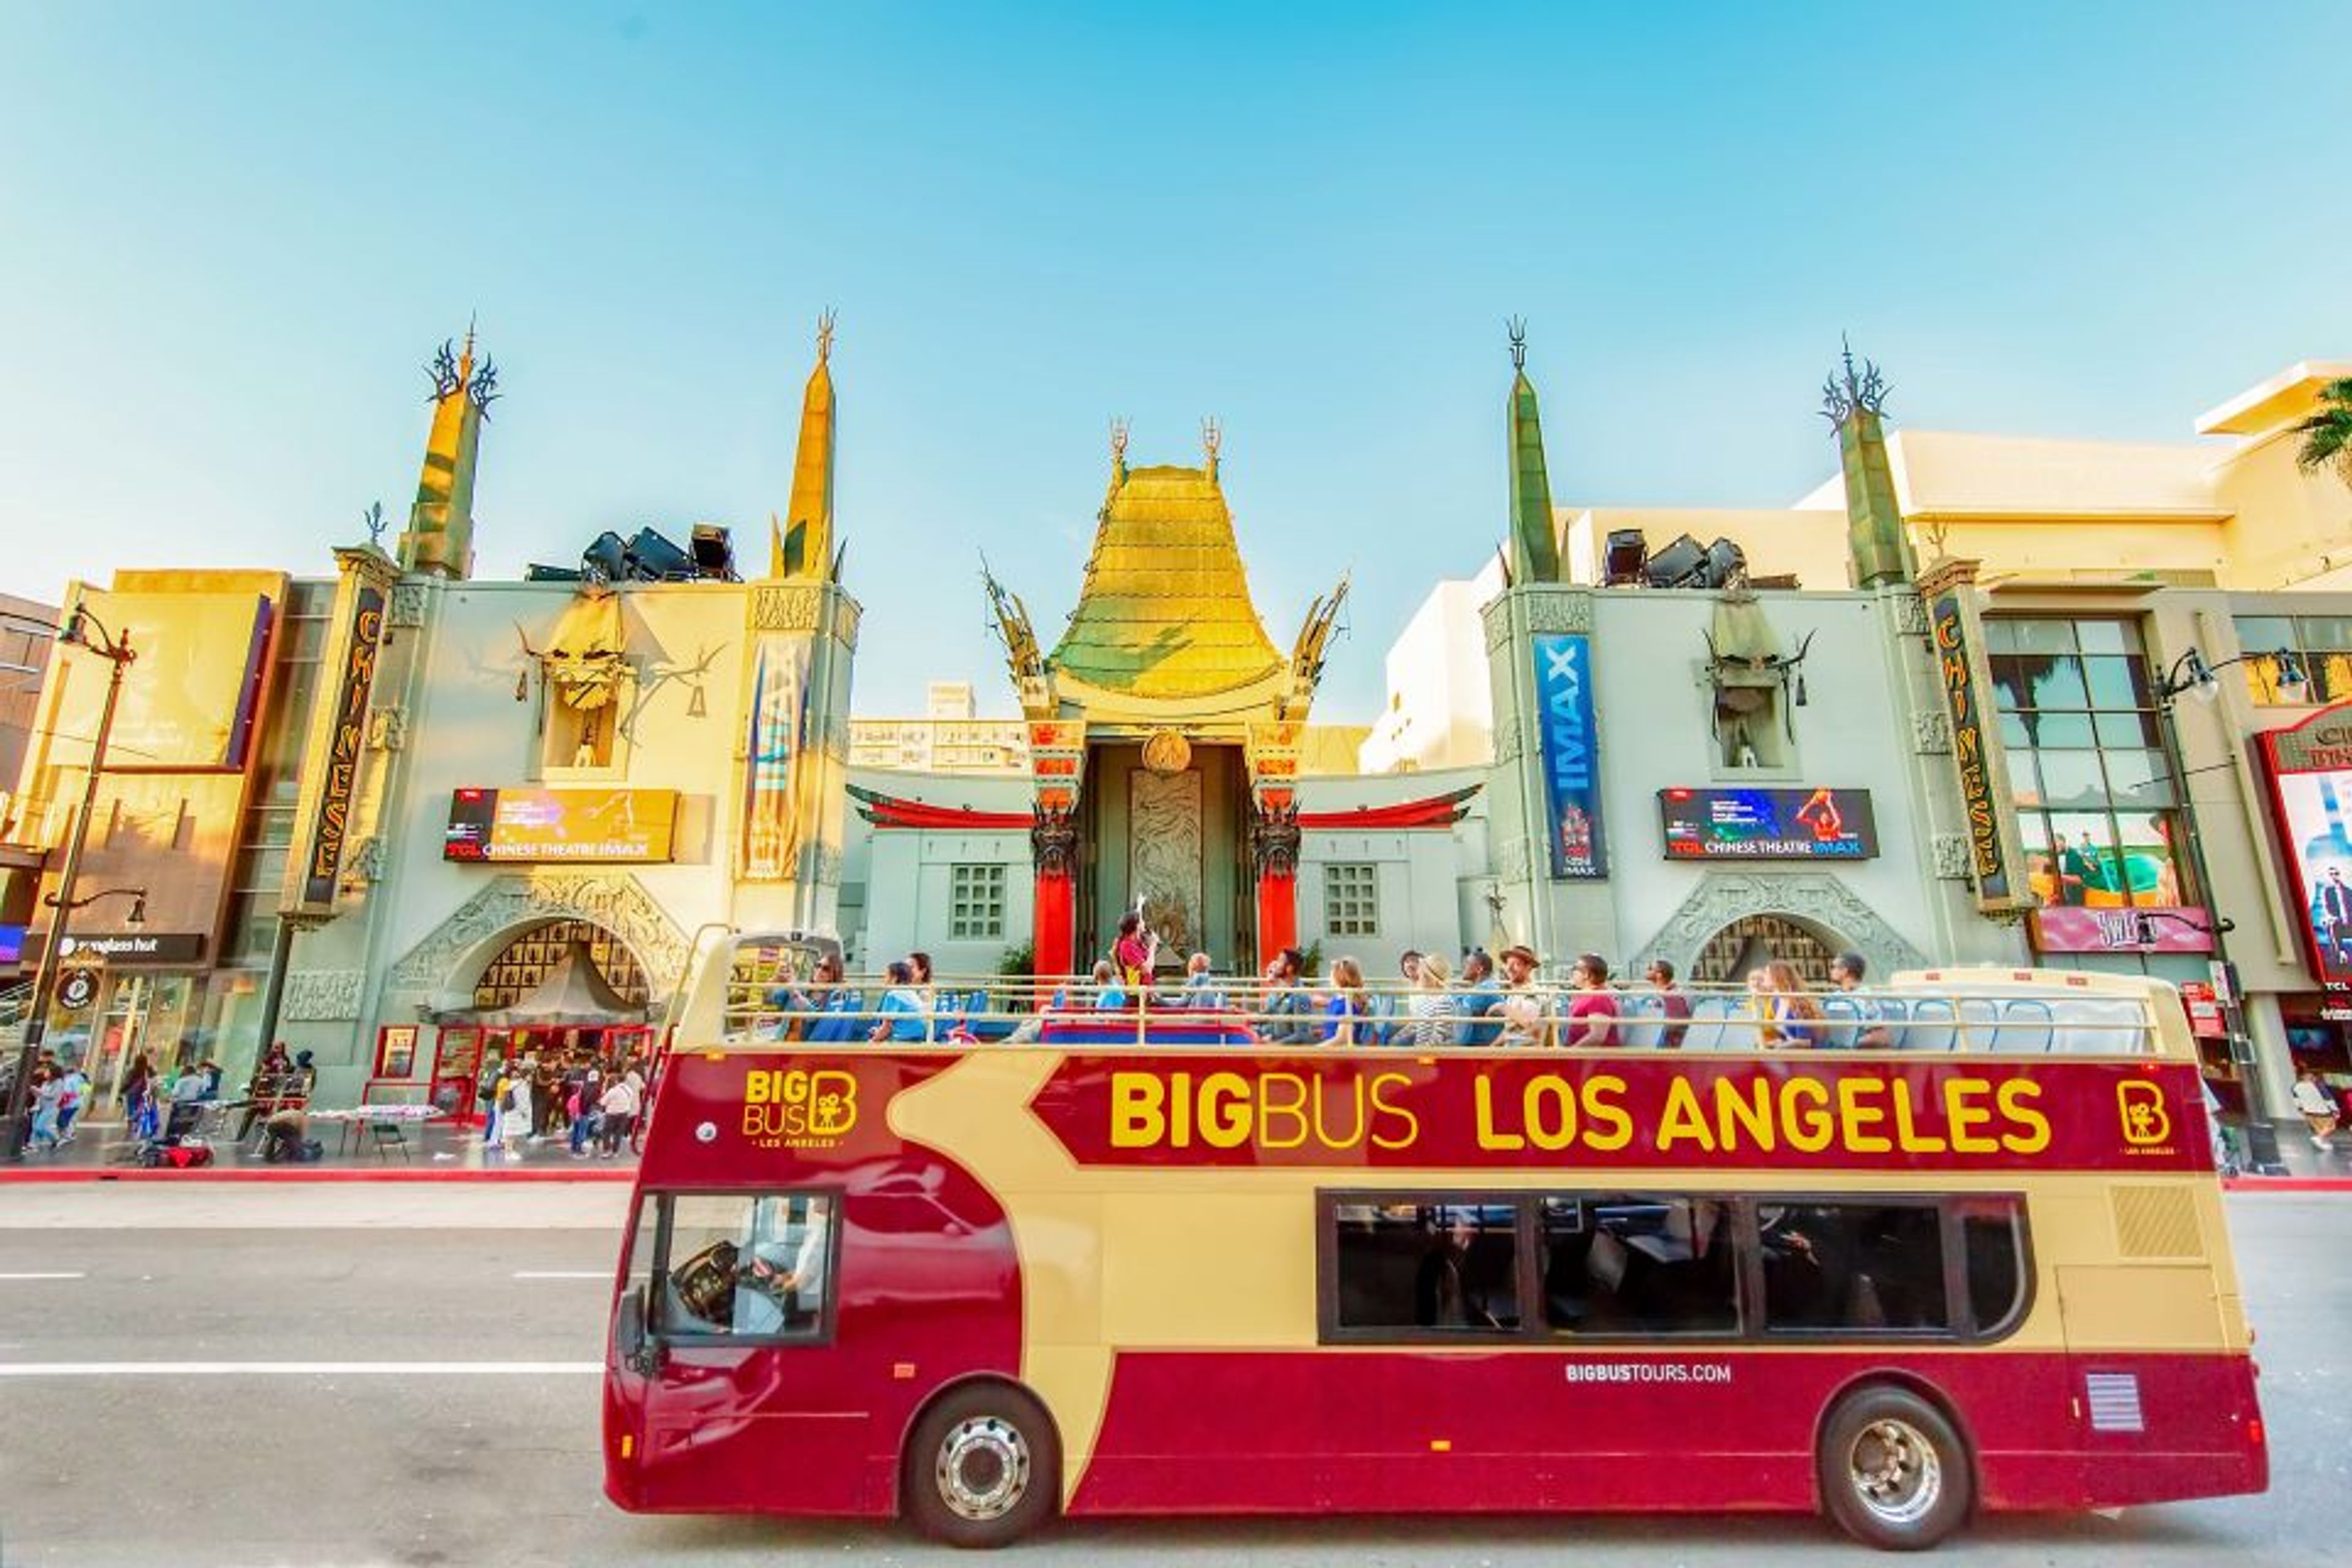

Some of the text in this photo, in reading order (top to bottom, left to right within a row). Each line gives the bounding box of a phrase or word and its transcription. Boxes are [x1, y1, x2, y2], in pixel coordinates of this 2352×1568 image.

[1545, 645, 1589, 789] IMAX
[315, 609, 380, 877] CHINESE
[1937, 614, 1998, 877] CHINESE
[1812, 842, 1861, 854] IMAX
[2325, 982, 2351, 991] TCL
[745, 1070, 808, 1104] BIG
[743, 1105, 805, 1136] BUS
[1474, 1074, 1634, 1151] LOS
[1656, 1076, 2052, 1153] ANGELES
[1566, 1364, 1732, 1383] BIGBUSTOURS.COM
